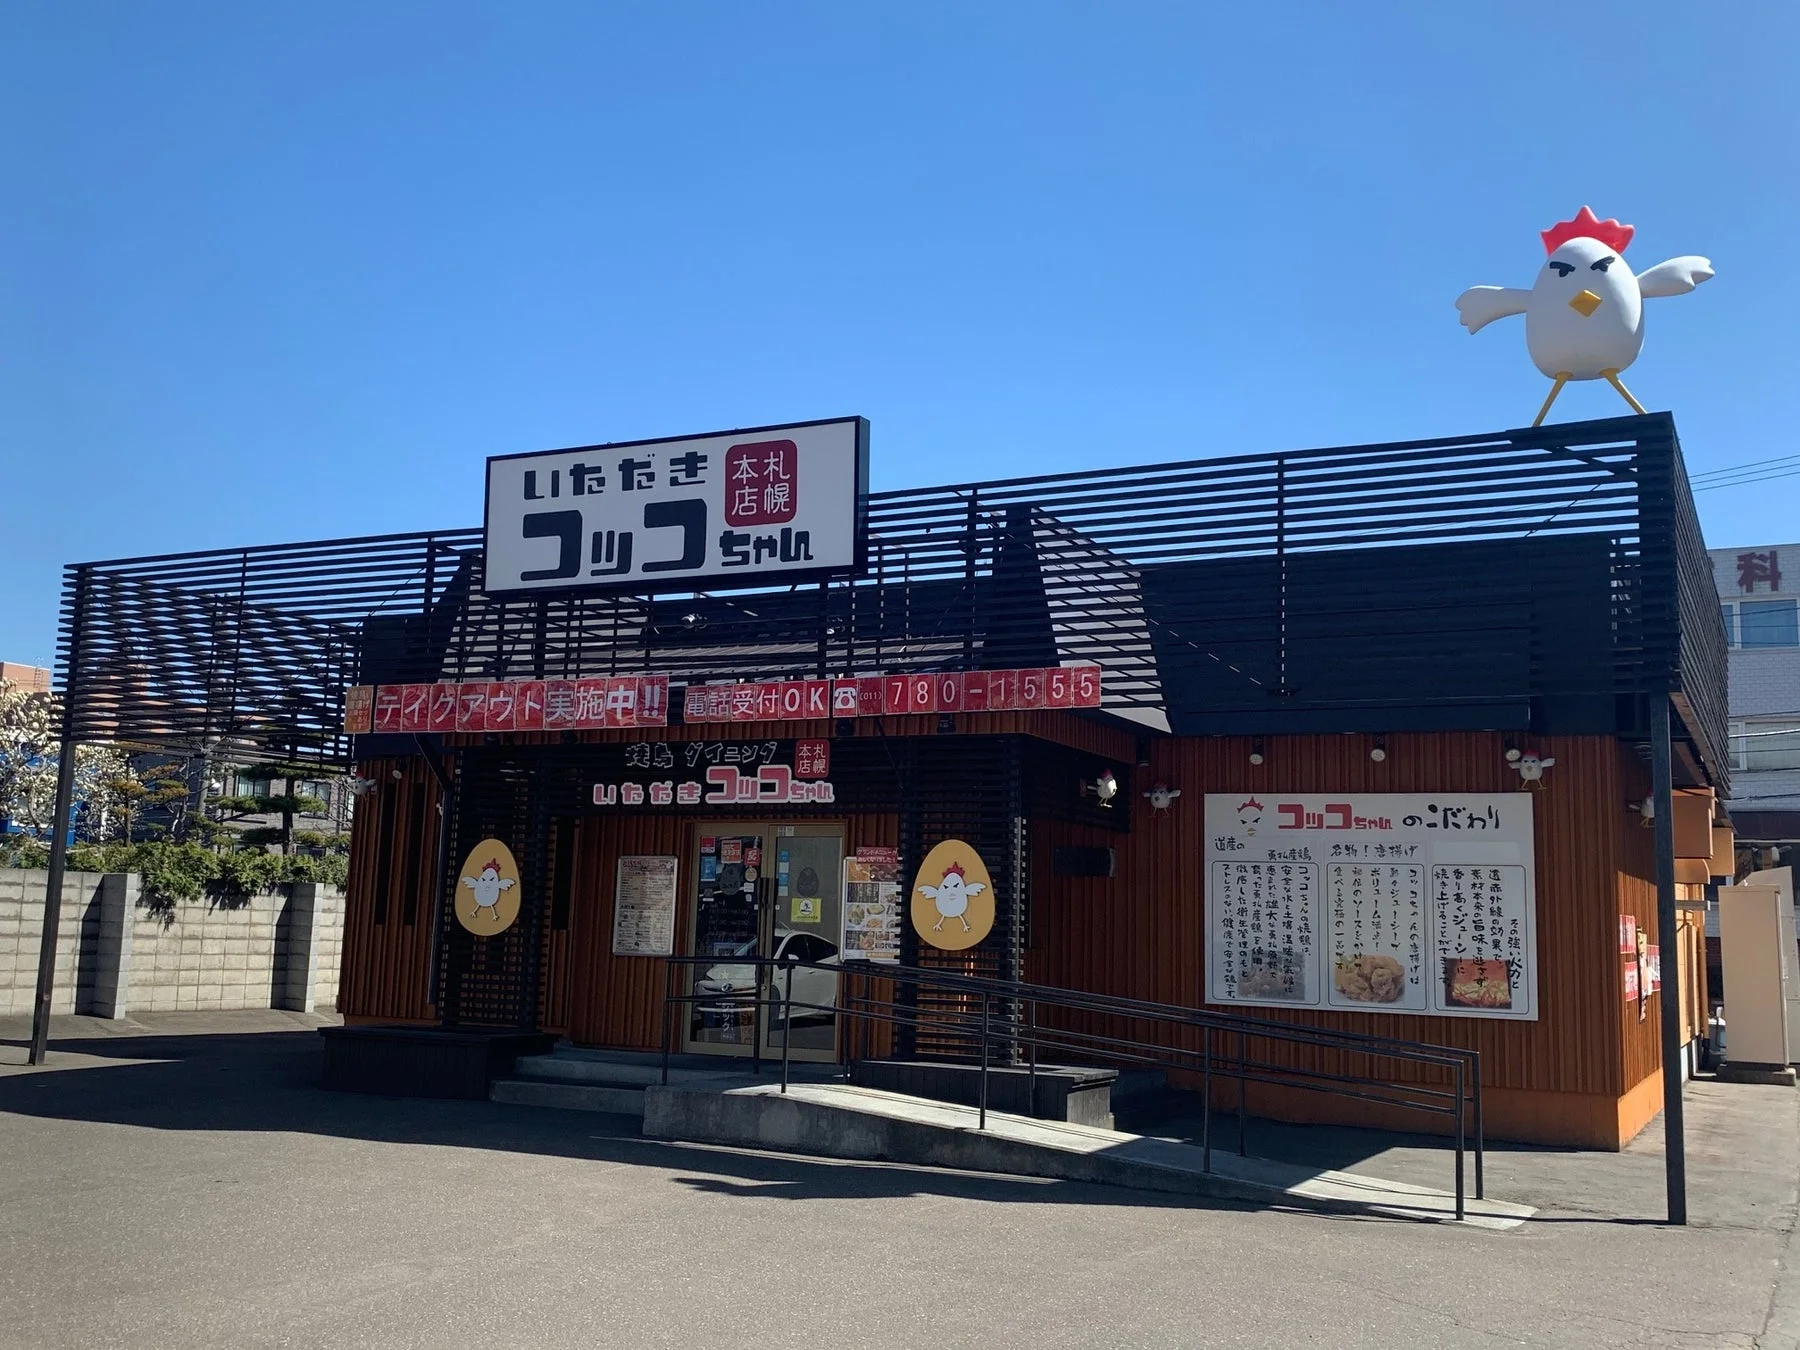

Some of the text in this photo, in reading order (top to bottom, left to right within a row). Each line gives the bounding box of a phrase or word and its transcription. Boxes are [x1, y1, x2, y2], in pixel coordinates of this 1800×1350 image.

[523, 451, 708, 500] いただき
[731, 454, 758, 517] 本店
[763, 449, 790, 515] 札幌
[520, 498, 814, 581] コッコちゃん
[1737, 551, 1782, 593] 科
[685, 741, 778, 767] ダイニング
[593, 764, 836, 805] いただき コッコちゃん
[1277, 803, 1501, 831] コッコちゃん のこだわり
